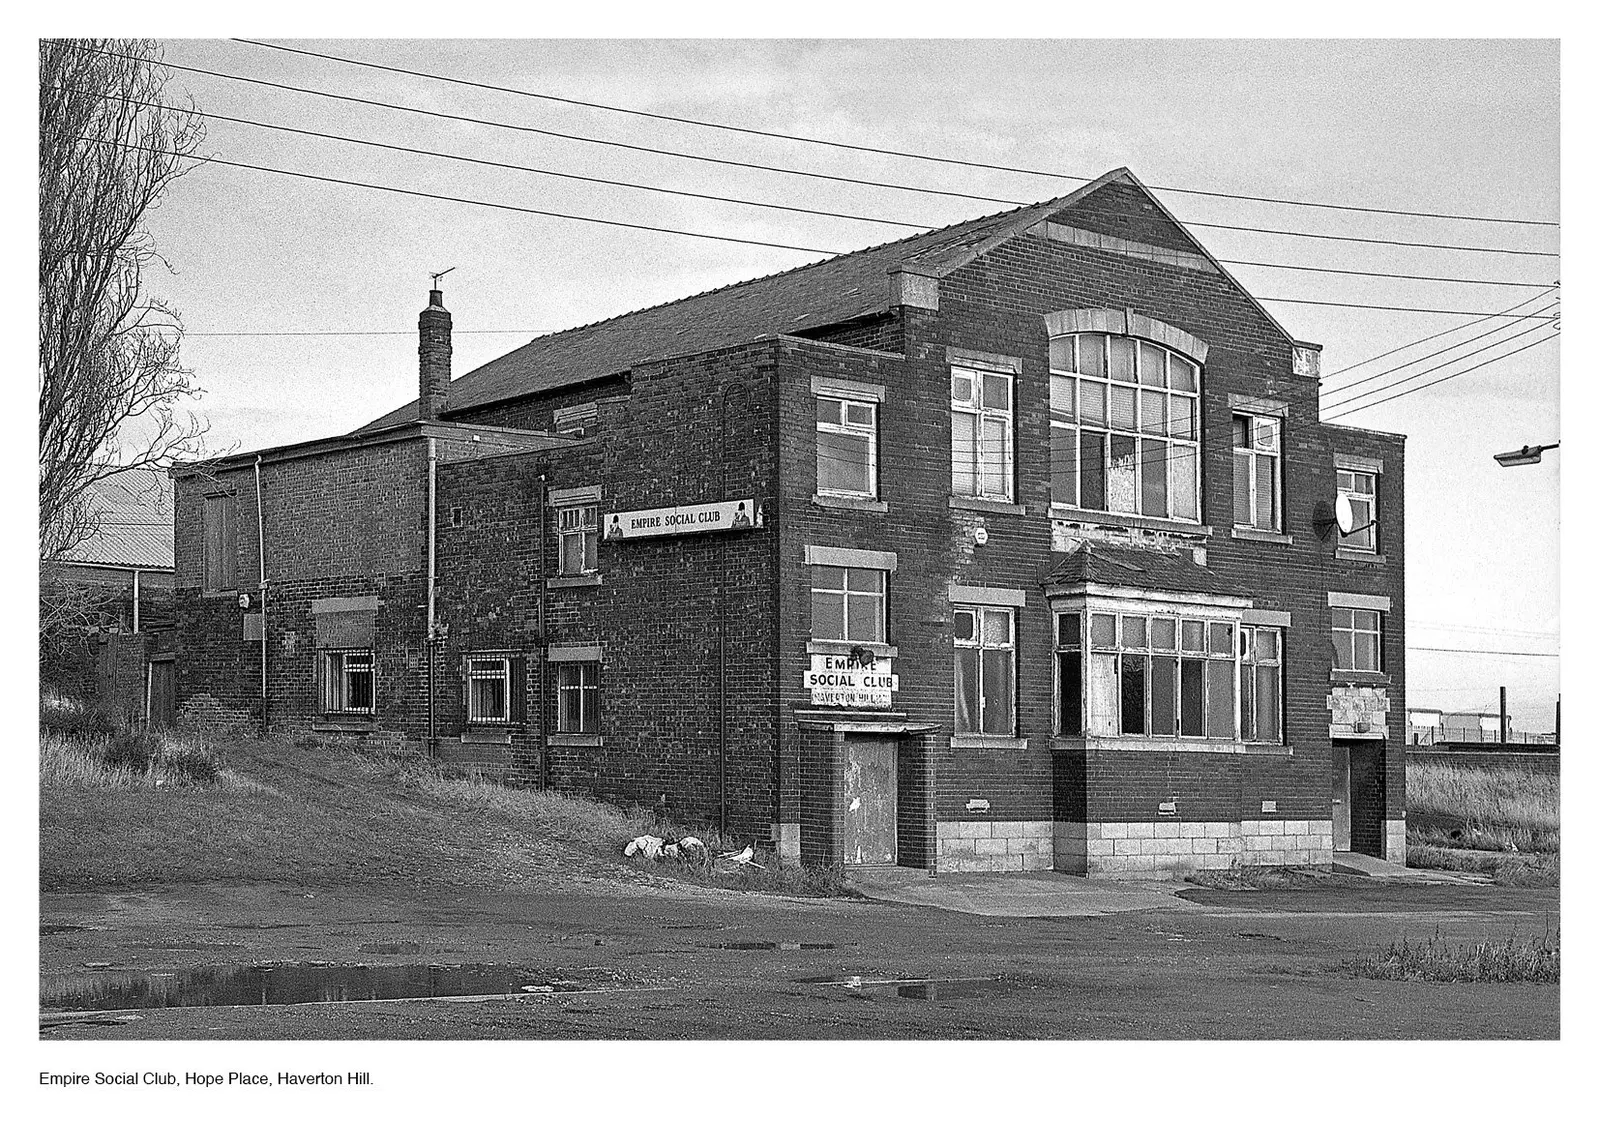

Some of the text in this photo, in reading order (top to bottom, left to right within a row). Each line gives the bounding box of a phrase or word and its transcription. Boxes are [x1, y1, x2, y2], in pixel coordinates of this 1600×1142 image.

[631, 511, 721, 530] EMPIRE SOCIAL CLUB
[810, 674, 893, 688] SOCIAL CLUB
